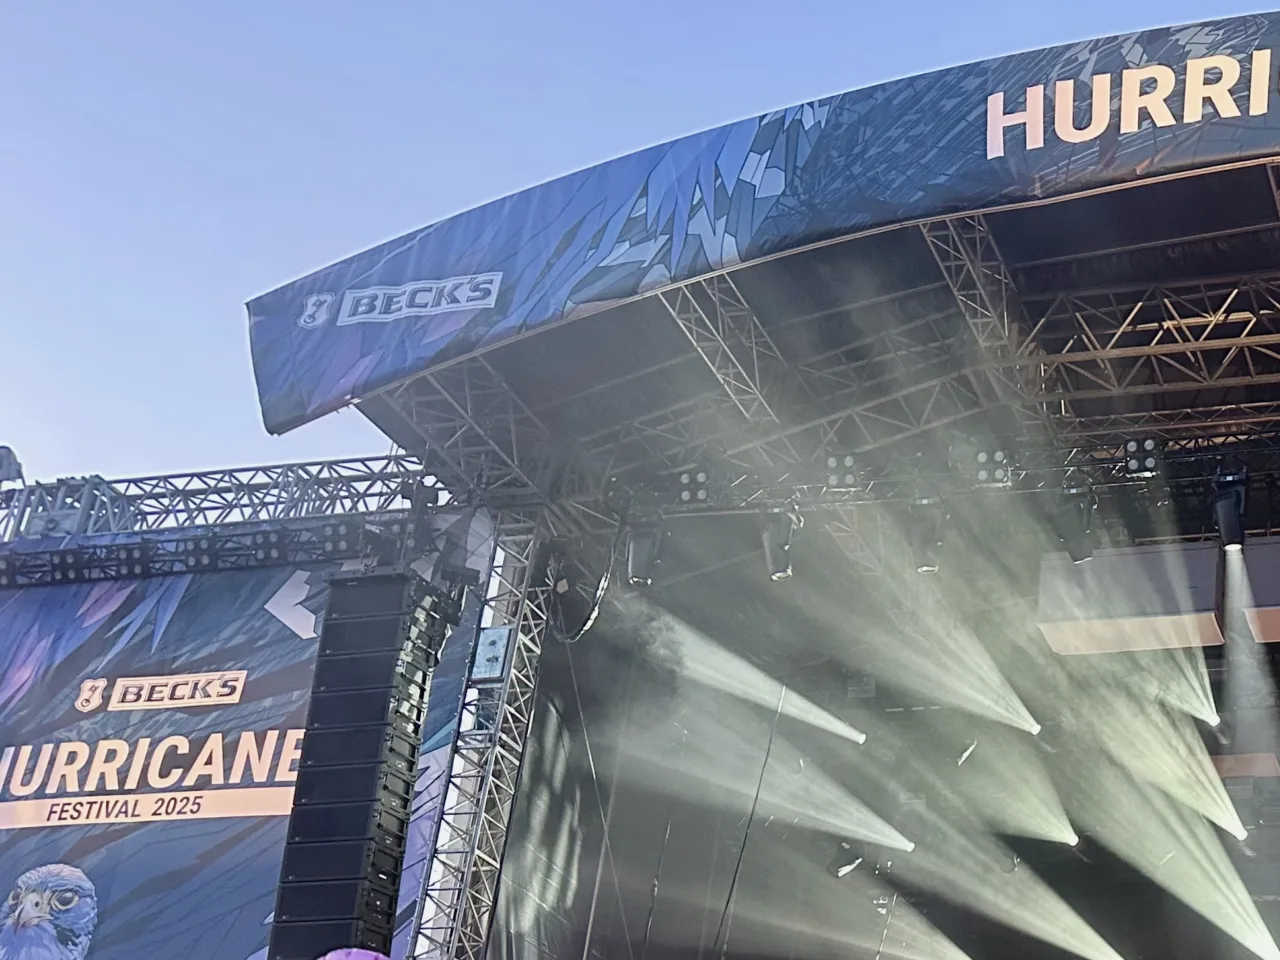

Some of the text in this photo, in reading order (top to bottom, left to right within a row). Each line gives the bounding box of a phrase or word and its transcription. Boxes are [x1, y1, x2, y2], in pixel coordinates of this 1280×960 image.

[348, 276, 494, 318] BECK'S
[116, 673, 240, 704] BECK'S
[46, 795, 203, 821] FESTIVAL 2025
